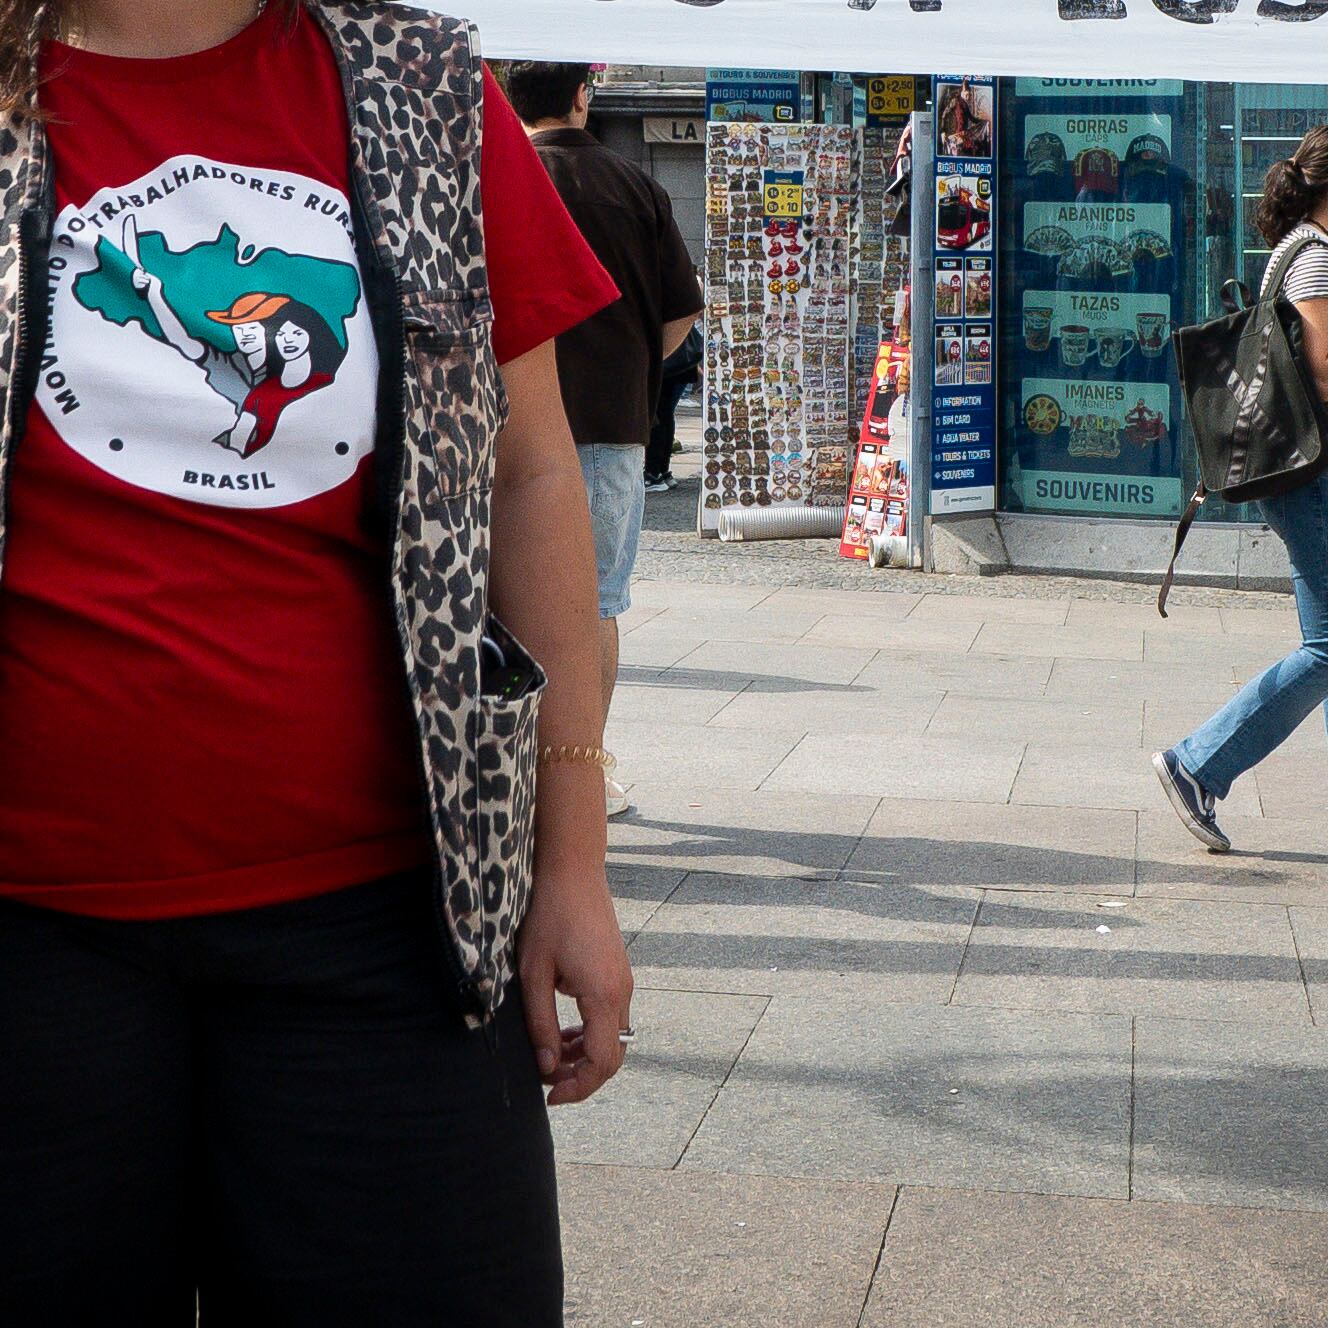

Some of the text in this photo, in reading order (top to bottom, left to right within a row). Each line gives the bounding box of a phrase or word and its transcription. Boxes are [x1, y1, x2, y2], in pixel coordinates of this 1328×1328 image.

[712, 88, 793, 100] BIGBUS MADRID
[896, 96, 910, 109] 10
[672, 121, 698, 141] LA
[1066, 119, 1128, 134] GORRAS
[87, 163, 297, 229] TRABALHADORES
[786, 202, 798, 213] 10
[1058, 207, 1136, 223] ABANICOS
[1085, 222, 1109, 232] FANS
[1070, 296, 1121, 312] TAZAS
[1065, 383, 1125, 401] IMANES
[955, 415, 971, 425] CARD
[182, 470, 276, 491] BRASIL
[1036, 478, 1154, 506] SOUVENIRS
